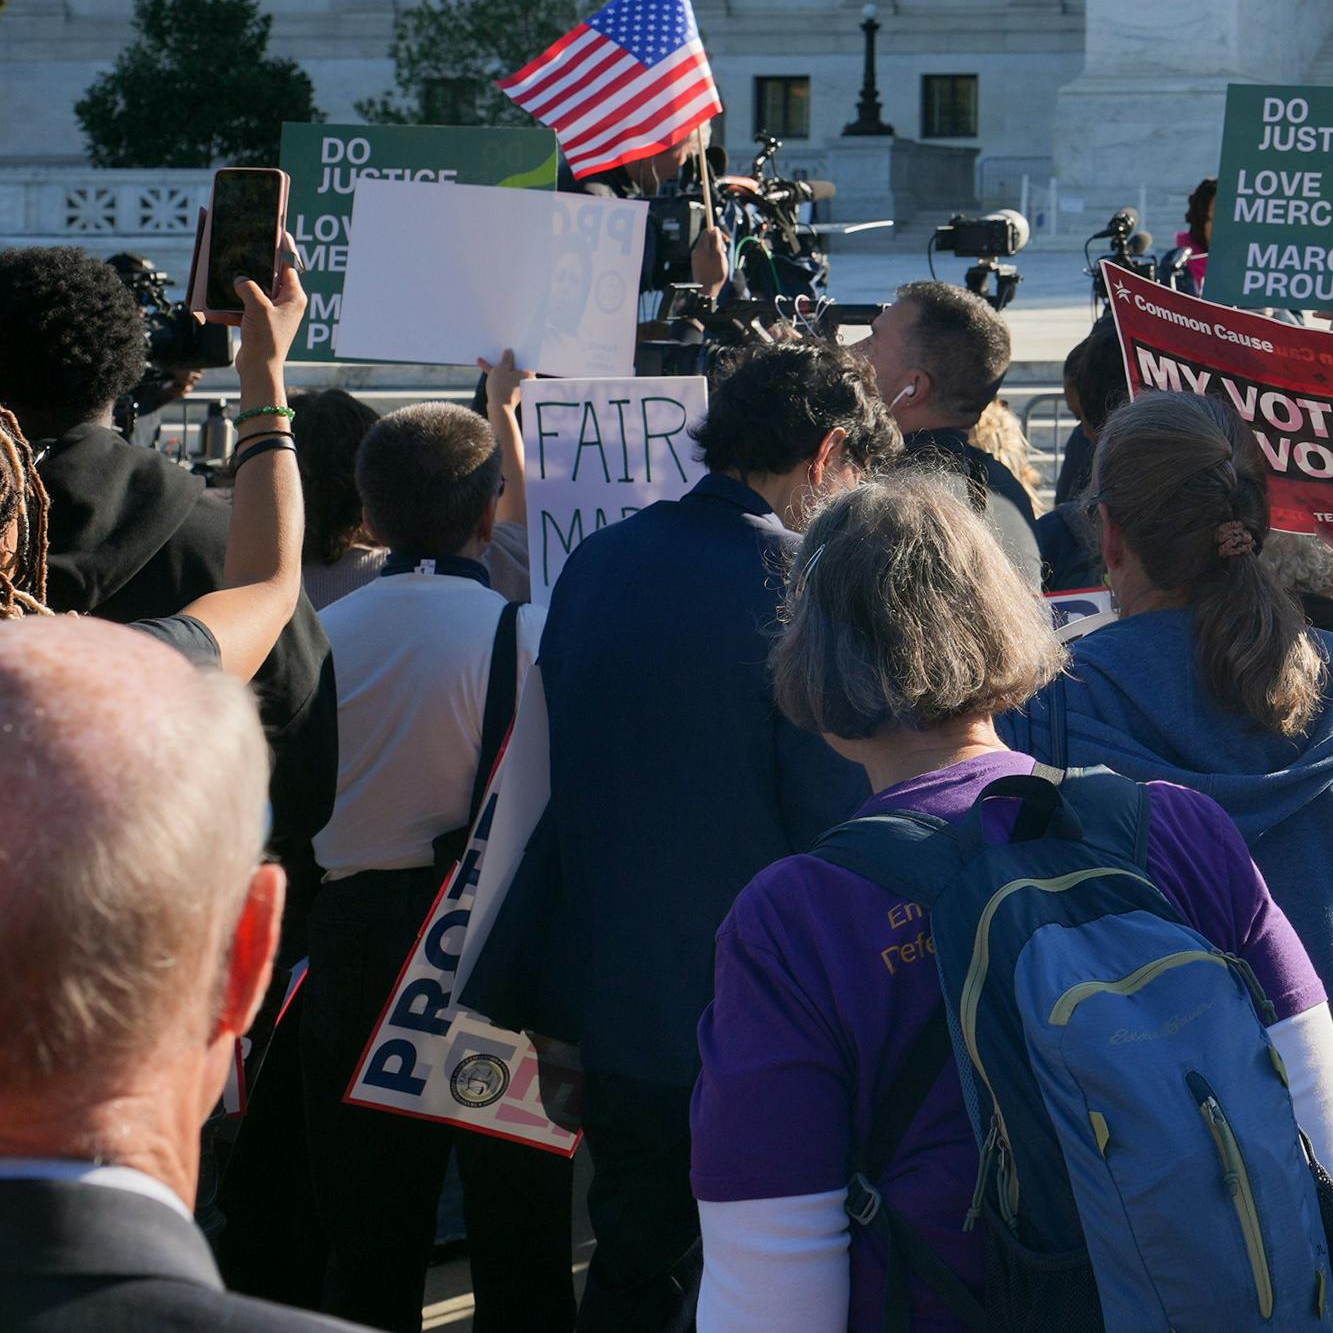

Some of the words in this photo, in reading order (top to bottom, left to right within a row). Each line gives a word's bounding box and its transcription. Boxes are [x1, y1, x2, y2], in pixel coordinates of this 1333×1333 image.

[1263, 97, 1309, 124] DO
[321, 137, 371, 165] DO
[1237, 169, 1323, 198] LOVE
[295, 214, 351, 242] LOV
[1134, 293, 1212, 334] Common
[1214, 323, 1274, 354] Cause
[1136, 346, 1213, 396] MY
[536, 397, 688, 483] FAIR
[362, 792, 499, 1096] PROT
